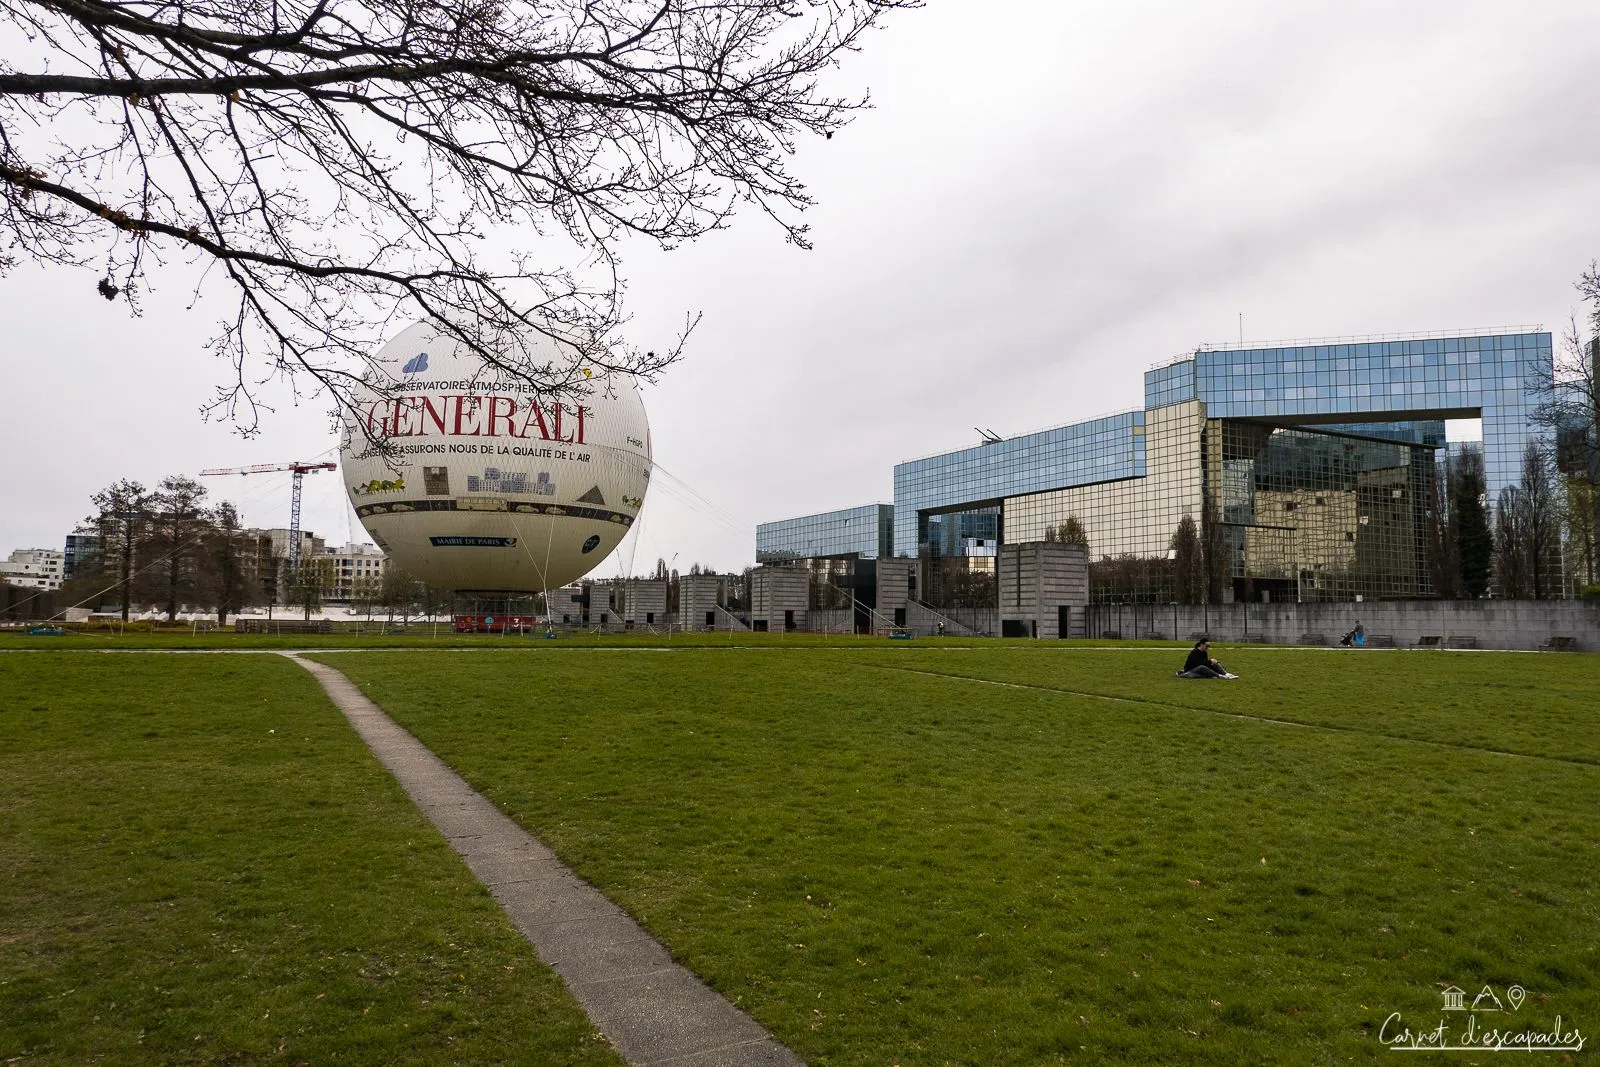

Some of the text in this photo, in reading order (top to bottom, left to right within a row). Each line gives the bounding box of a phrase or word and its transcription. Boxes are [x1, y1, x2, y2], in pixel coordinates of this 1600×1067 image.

[393, 380, 465, 392] OBSERVATOIRE
[367, 395, 587, 445] GENERALI
[398, 444, 446, 455] ASSURONS
[448, 444, 477, 454] NOUS
[480, 445, 494, 455] DE
[497, 446, 510, 455] LA
[512, 444, 552, 459] QUALITÉ
[554, 450, 567, 460] DE
[576, 453, 591, 463] AIR
